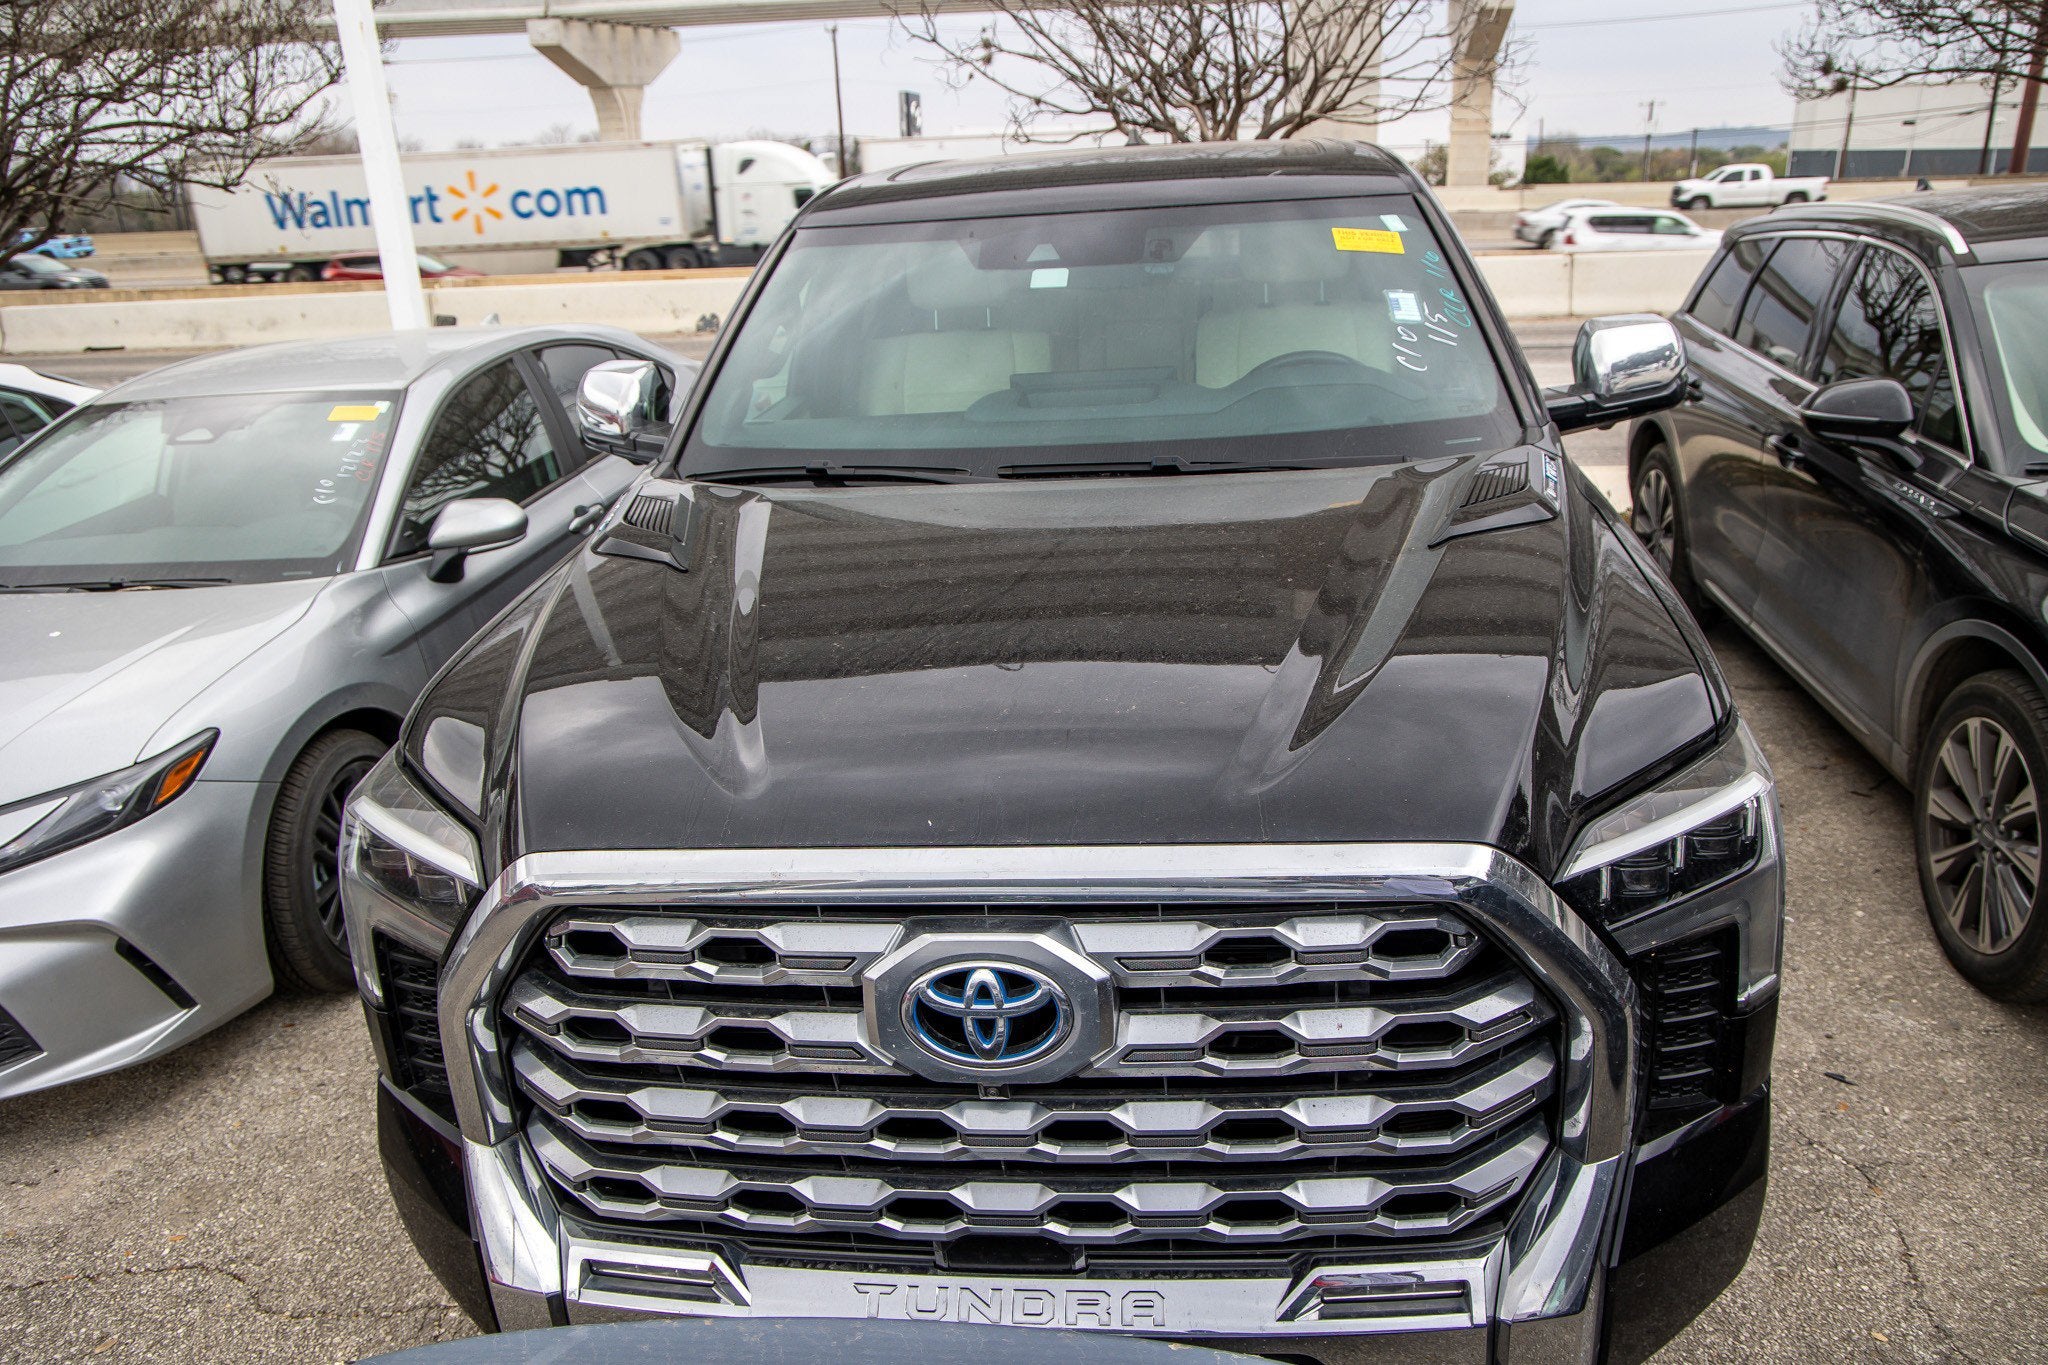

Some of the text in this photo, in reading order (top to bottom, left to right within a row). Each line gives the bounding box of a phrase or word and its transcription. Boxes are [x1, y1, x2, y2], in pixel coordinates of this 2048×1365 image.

[265, 185, 606, 230] Walmrt com
[853, 1282, 1166, 1327] TUNDRA
